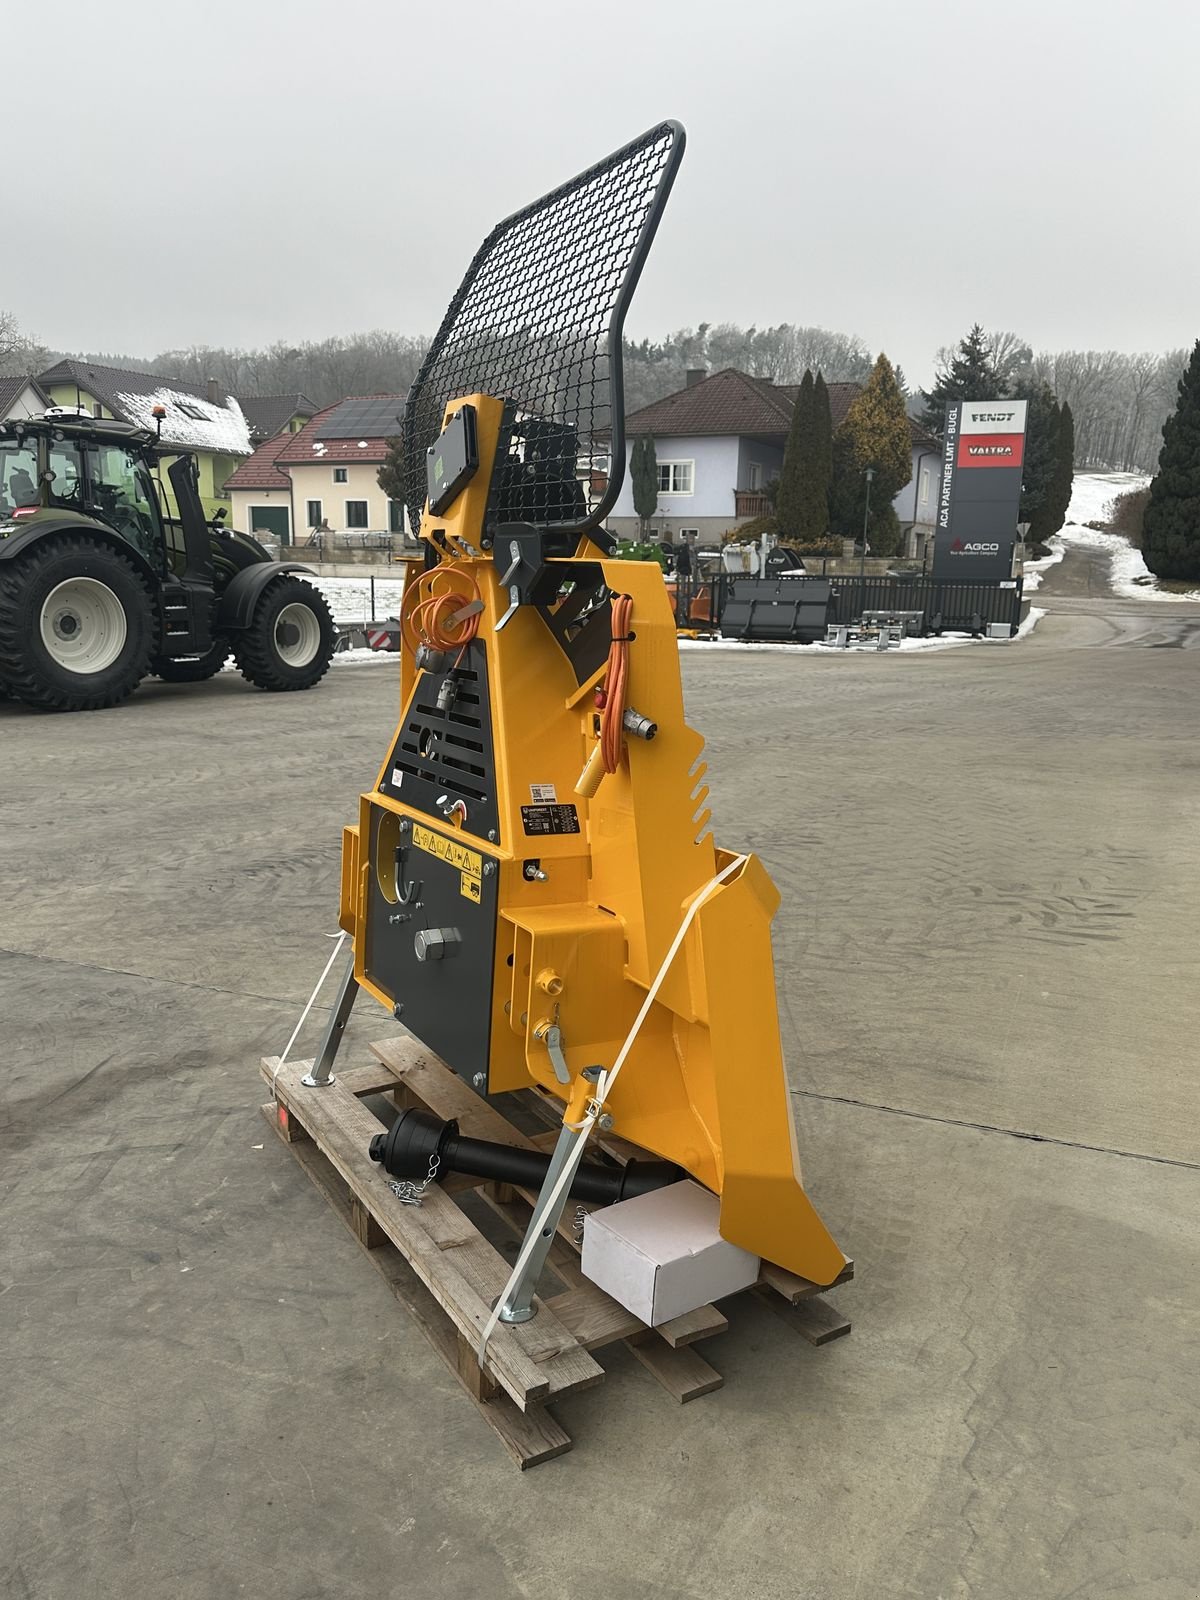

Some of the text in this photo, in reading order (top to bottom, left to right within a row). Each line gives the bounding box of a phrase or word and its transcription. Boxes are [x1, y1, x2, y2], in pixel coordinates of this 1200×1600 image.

[948, 407, 958, 434] BUGL
[971, 412, 1016, 422] FENDT
[945, 441, 955, 463] LMT
[968, 446, 1013, 456] VALTRA
[942, 463, 953, 506] PARTNER
[940, 508, 949, 528] ACA
[964, 543, 999, 551] AGCO
